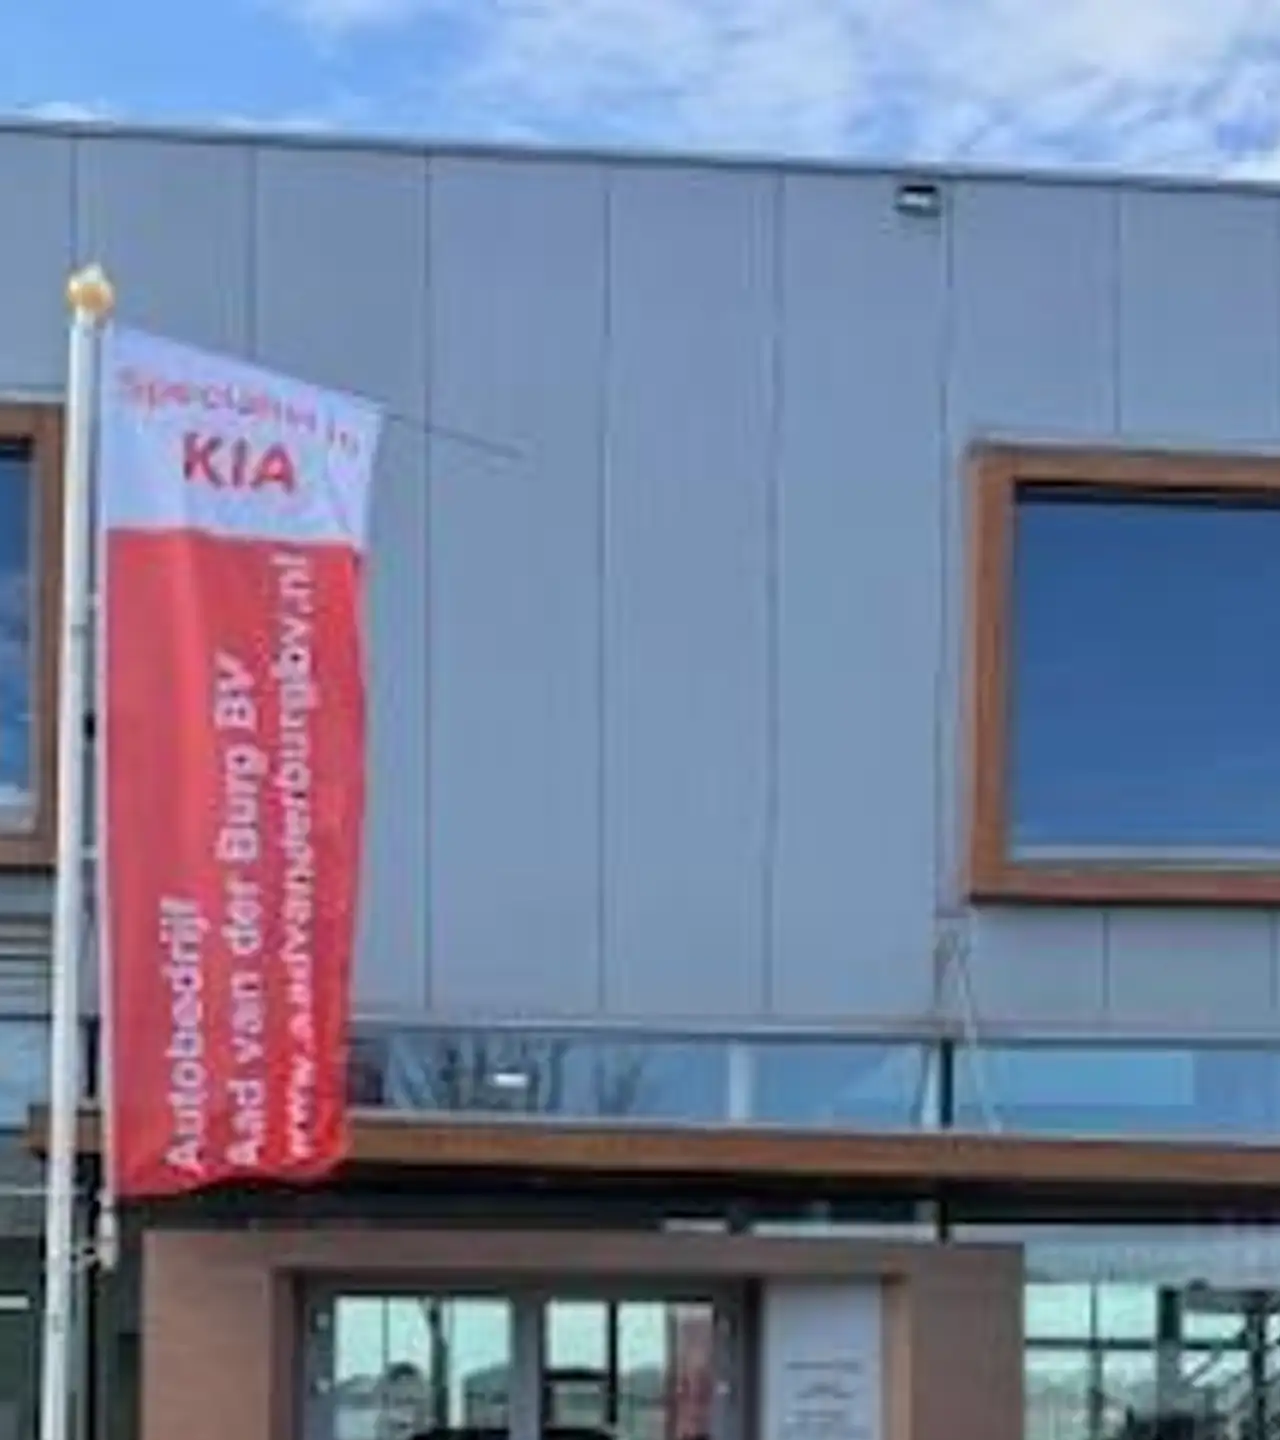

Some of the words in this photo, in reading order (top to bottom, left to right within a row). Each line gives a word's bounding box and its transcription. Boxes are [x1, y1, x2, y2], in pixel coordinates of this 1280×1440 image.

[183, 431, 296, 496] KIA
[214, 649, 256, 731] BV
[217, 743, 268, 862] Burg
[222, 877, 262, 956] der
[159, 896, 208, 1173] Autobedrijf
[231, 972, 263, 1064] van
[227, 1079, 265, 1167] Aad
